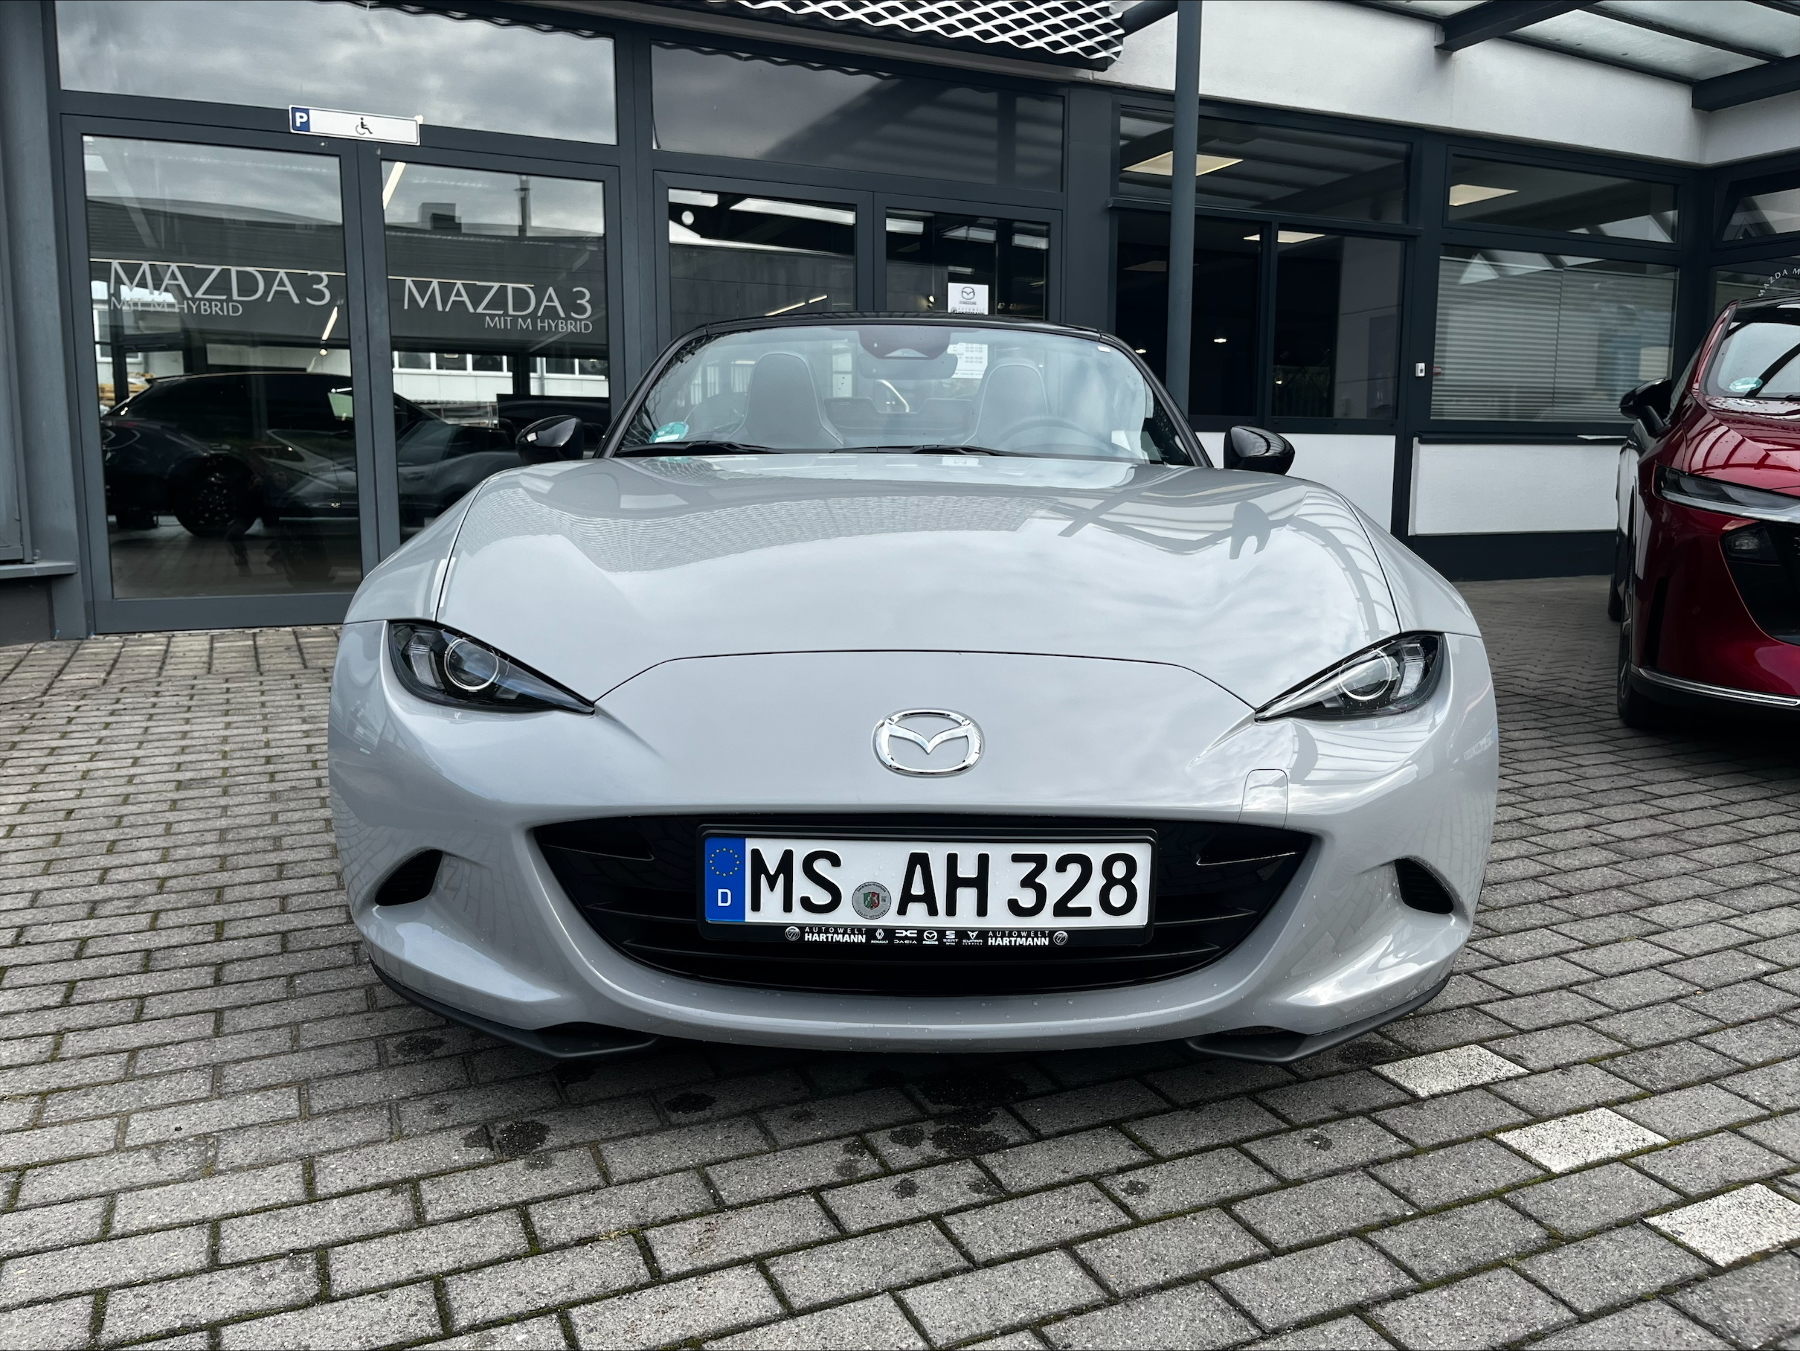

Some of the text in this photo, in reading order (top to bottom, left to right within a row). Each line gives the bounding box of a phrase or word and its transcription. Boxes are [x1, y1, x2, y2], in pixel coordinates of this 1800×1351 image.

[295, 112, 308, 127] P
[1758, 269, 1788, 297] MAZDA
[110, 297, 243, 316] MIT M HYBRID
[485, 316, 593, 333] MIT M HYBRID
[750, 848, 1138, 918] MS AH 328
[717, 889, 732, 906] D
[804, 926, 867, 934] AUTOWELT
[804, 933, 867, 943] HARTMANN
[987, 937, 1049, 946] HARTMANN
